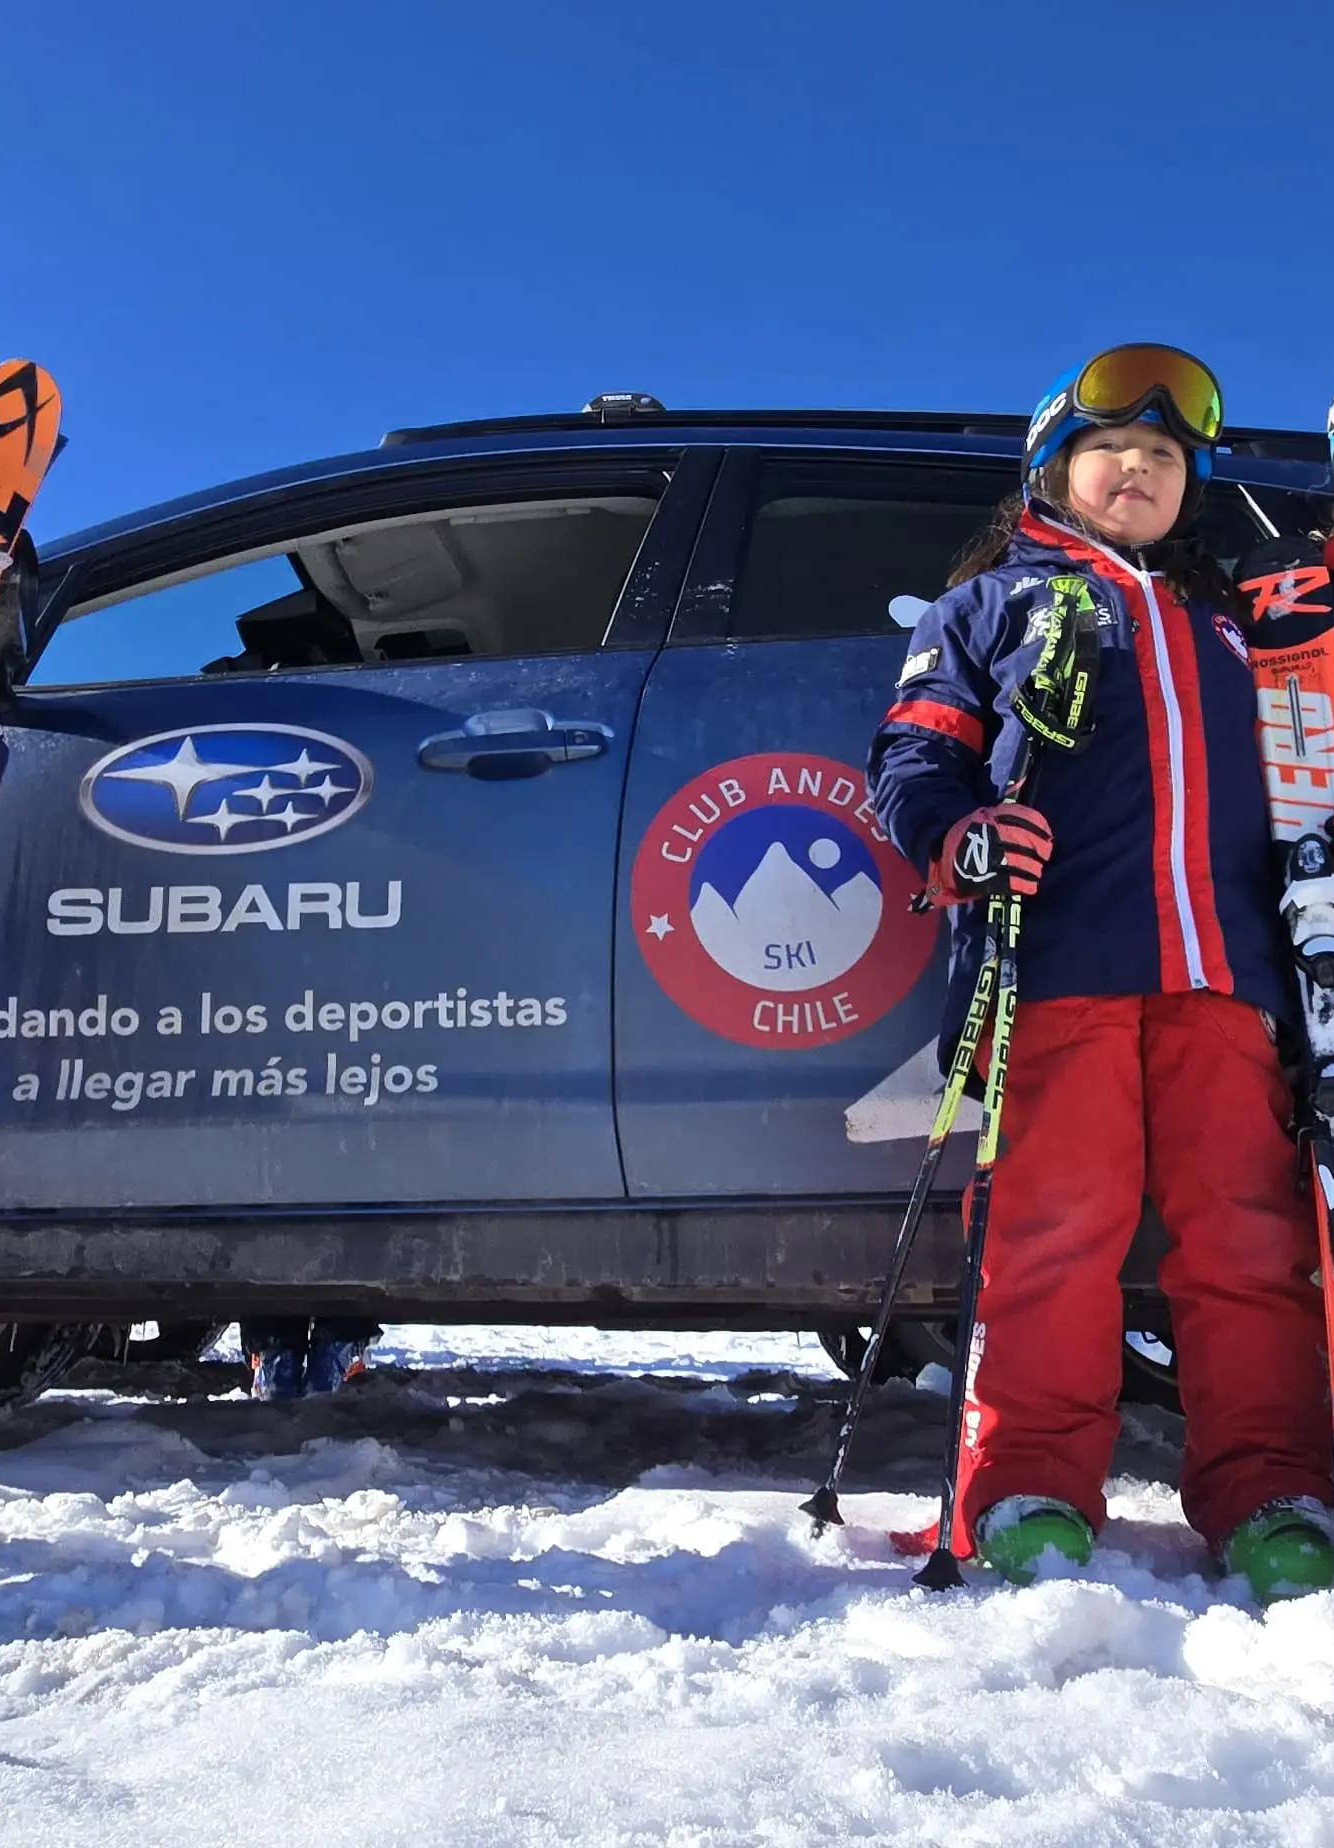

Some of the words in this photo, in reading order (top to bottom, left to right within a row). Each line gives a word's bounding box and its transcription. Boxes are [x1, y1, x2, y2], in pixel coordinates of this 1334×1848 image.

[1067, 671, 1088, 729] GABE
[661, 778, 748, 864] CLUB
[46, 879, 402, 936] SUBARU
[763, 940, 817, 970] SKI
[157, 1007, 183, 1034] a
[201, 991, 268, 1035] los
[284, 989, 569, 1044] deportistas
[752, 991, 860, 1034] CHILE
[947, 965, 996, 1089] GABEL
[13, 1073, 40, 1101] a
[55, 1058, 196, 1112] llegar
[211, 1056, 309, 1098] más
[326, 1053, 440, 1107] lejos
